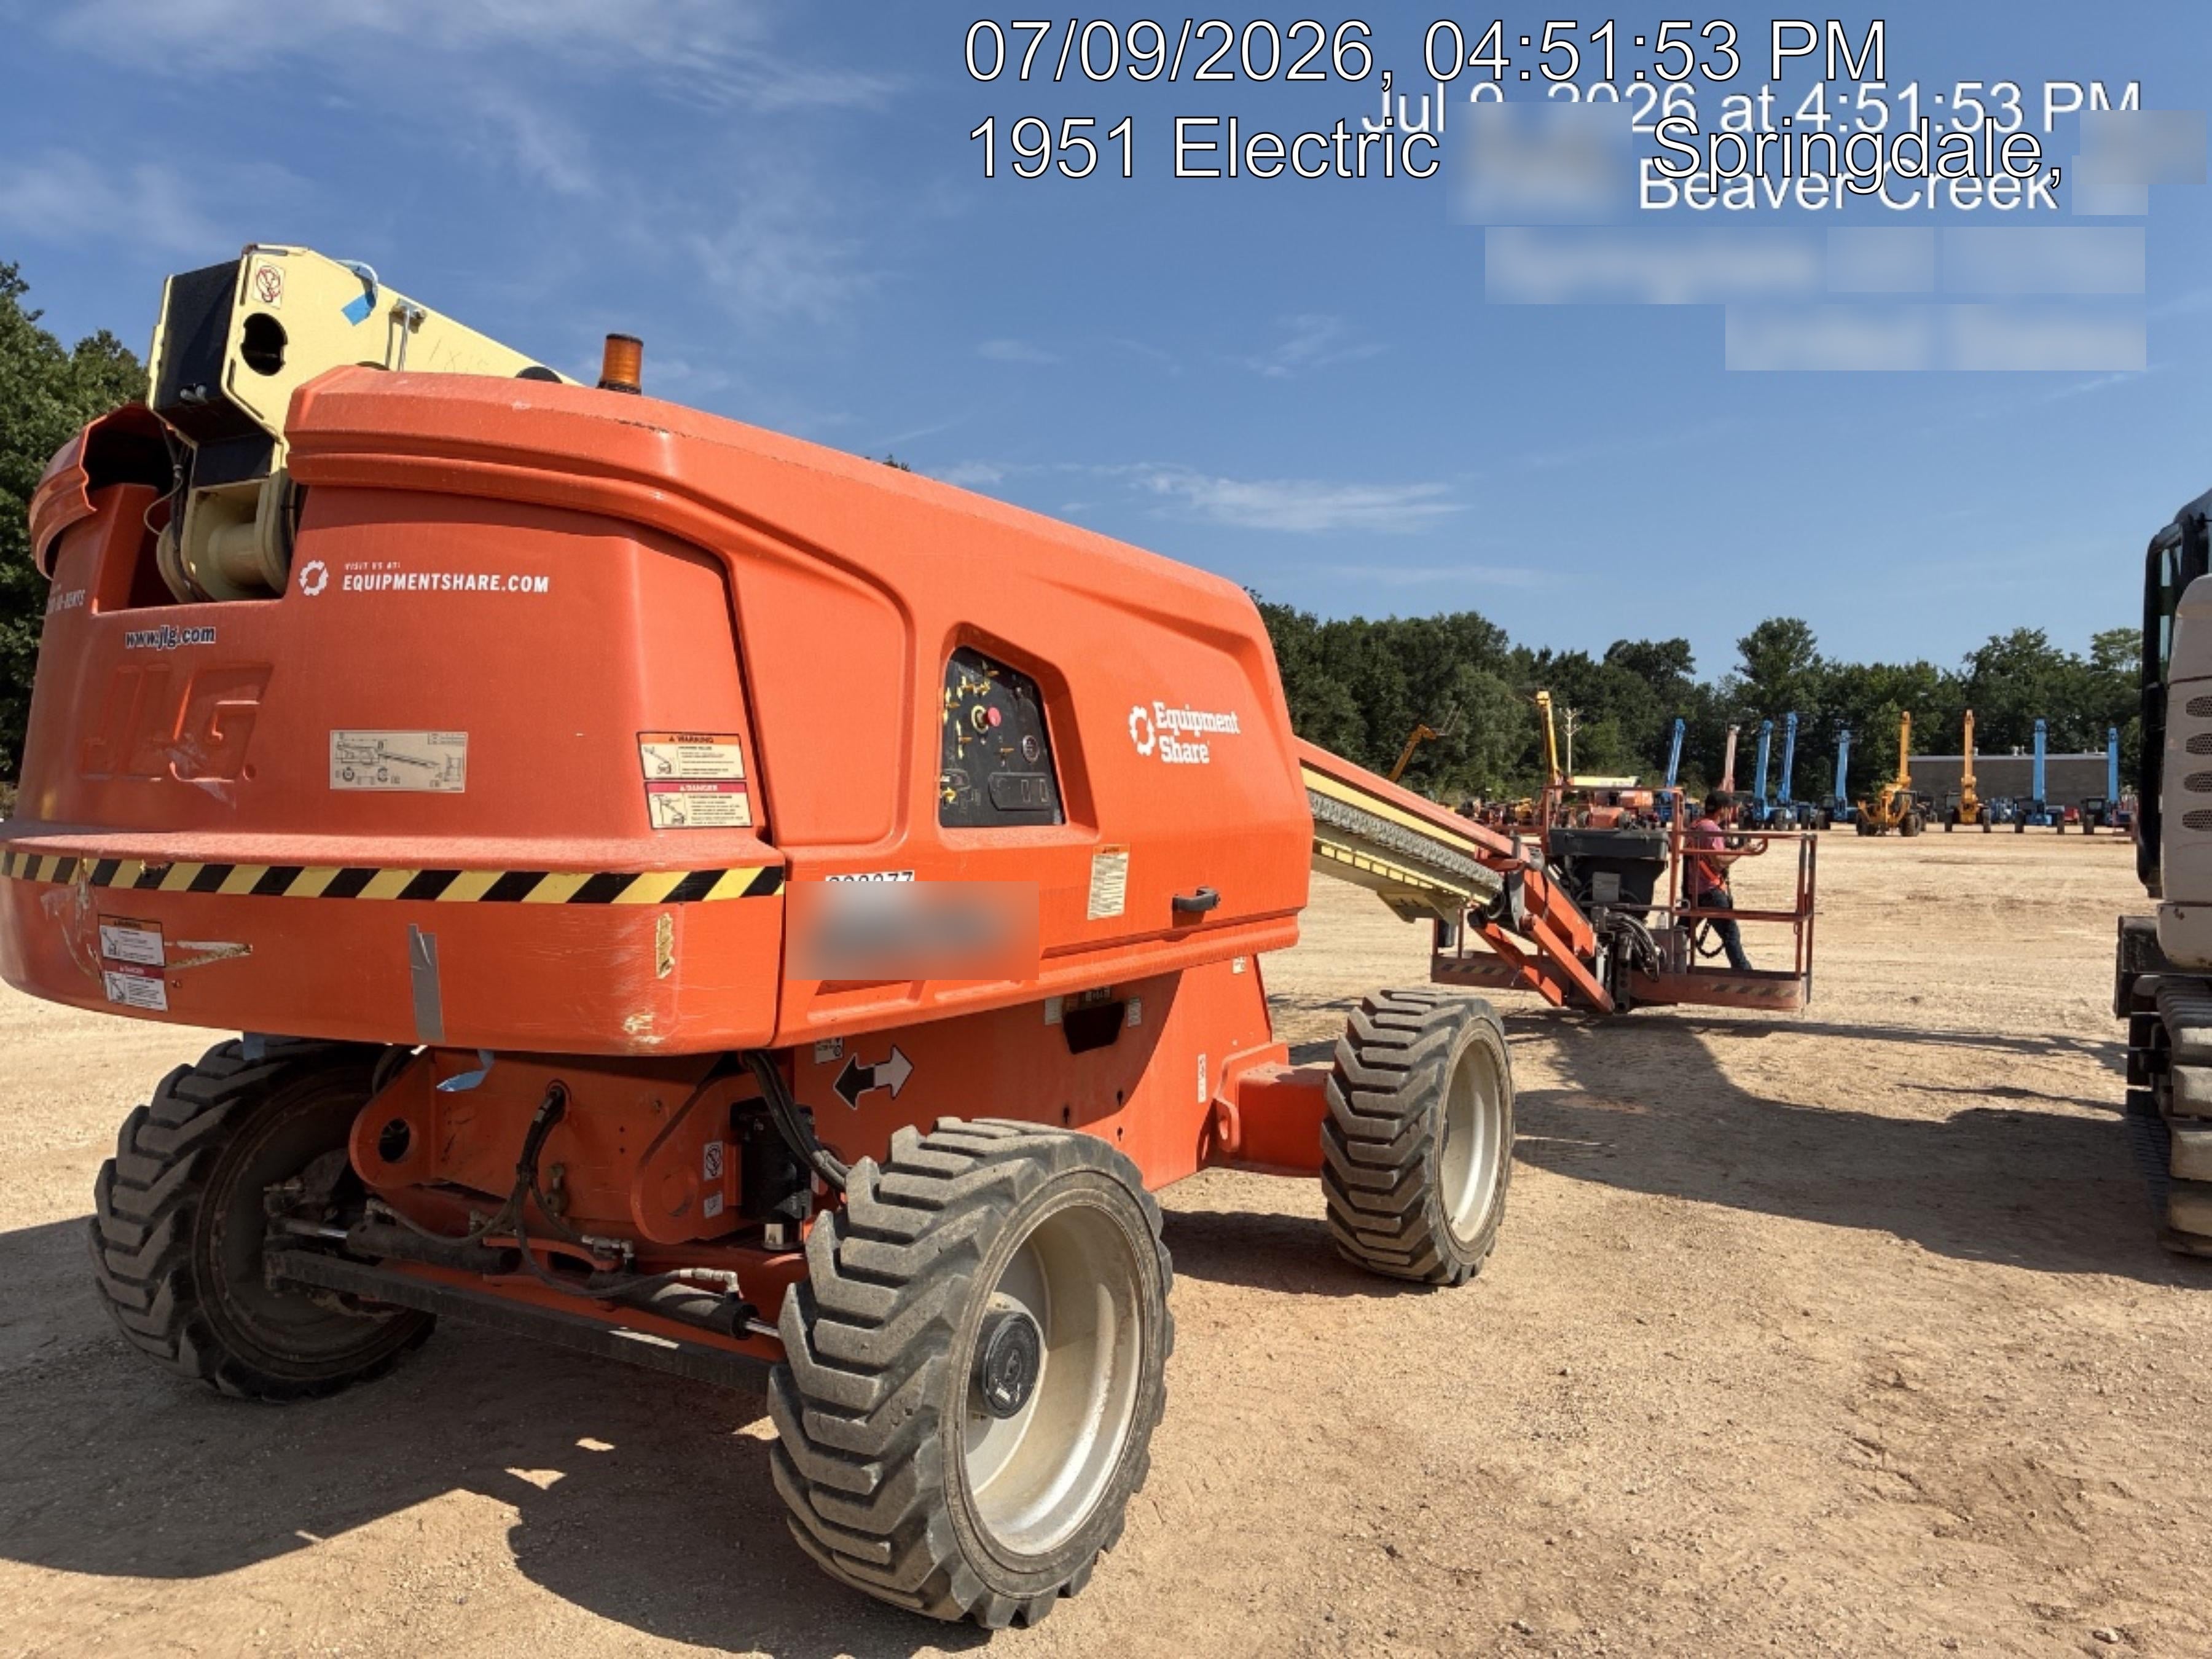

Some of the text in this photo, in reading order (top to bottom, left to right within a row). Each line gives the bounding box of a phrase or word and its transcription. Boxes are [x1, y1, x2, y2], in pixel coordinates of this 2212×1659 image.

[342, 572, 550, 593] EQUIPMENTSHARE.COM
[125, 624, 216, 651] www.jlg.com
[1152, 700, 1241, 737] Equipment
[1158, 735, 1210, 764] Share
